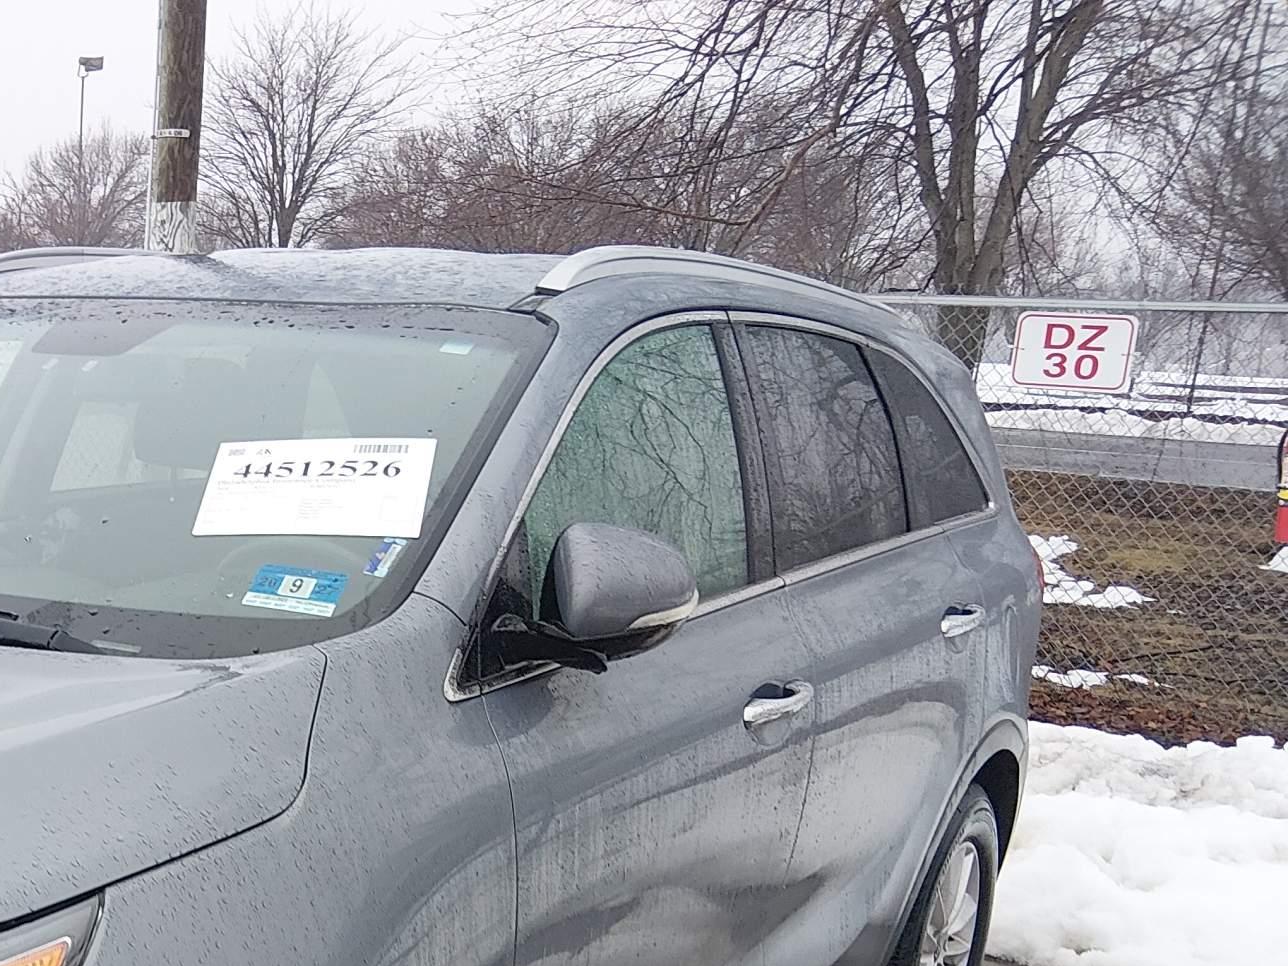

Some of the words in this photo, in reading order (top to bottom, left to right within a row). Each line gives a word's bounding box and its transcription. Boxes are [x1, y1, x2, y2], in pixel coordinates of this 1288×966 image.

[1043, 323, 1109, 352] DZ
[1043, 352, 1099, 380] 30
[233, 459, 402, 479] 44512526
[288, 577, 304, 594] 9
